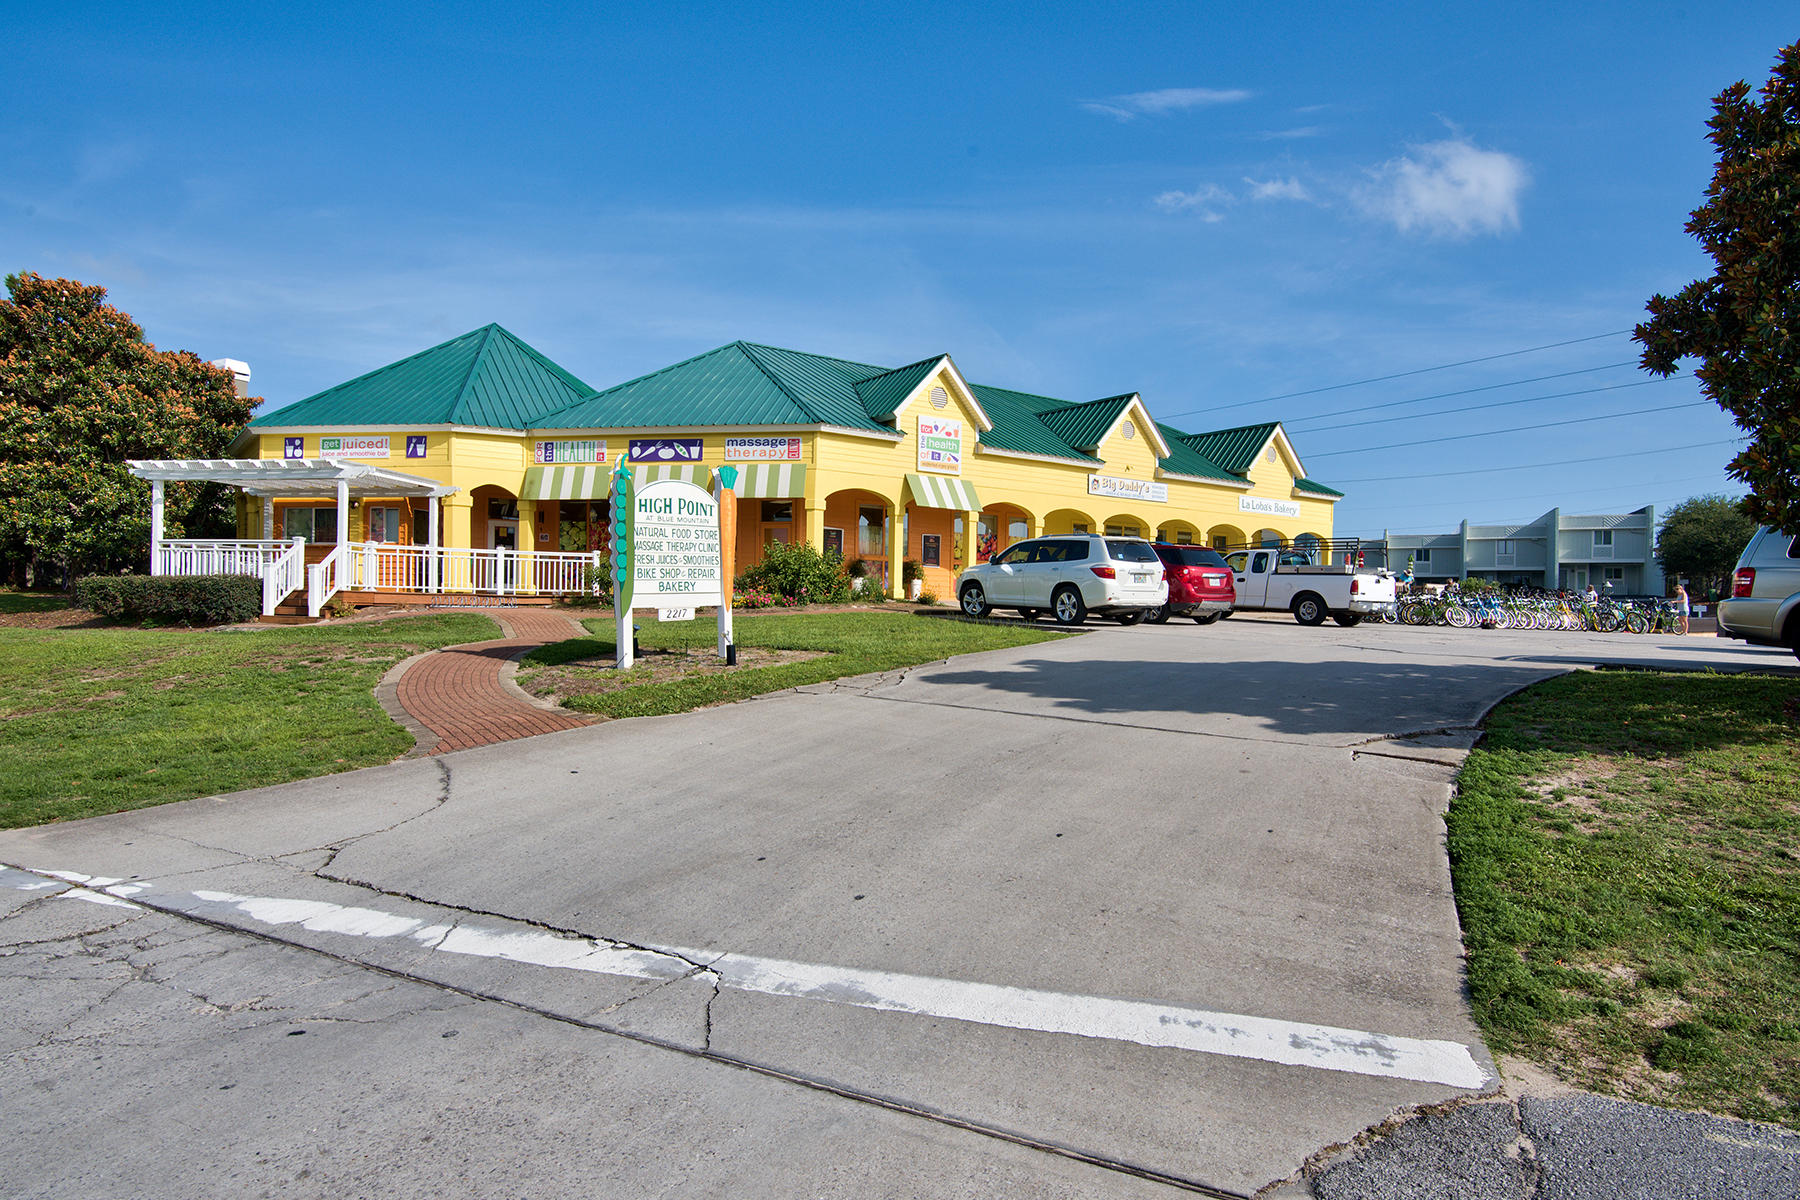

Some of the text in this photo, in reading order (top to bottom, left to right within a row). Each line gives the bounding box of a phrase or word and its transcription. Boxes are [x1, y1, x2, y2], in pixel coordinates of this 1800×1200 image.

[323, 438, 388, 451] get juiced!
[726, 438, 786, 448] massage
[928, 438, 958, 450] health
[554, 441, 596, 462] HEALTH
[727, 448, 786, 458] therapy
[920, 450, 930, 459] of
[1102, 478, 1116, 492] Big
[1118, 480, 1150, 495] Daddy's
[638, 498, 714, 516] HIGH POINT
[1242, 498, 1297, 516] La Loba's Bakery
[634, 526, 718, 540] NATURAL FOOD STORE
[666, 542, 697, 552] THERAPY
[698, 543, 720, 552] CLINIC
[656, 554, 678, 565] JUICES
[682, 555, 720, 566] SMOOTHIES
[636, 568, 656, 578] BIKE
[660, 568, 681, 578] SHOP
[688, 568, 716, 578] REPAIR
[658, 582, 696, 592] BAKERY
[666, 608, 688, 618] 2217
